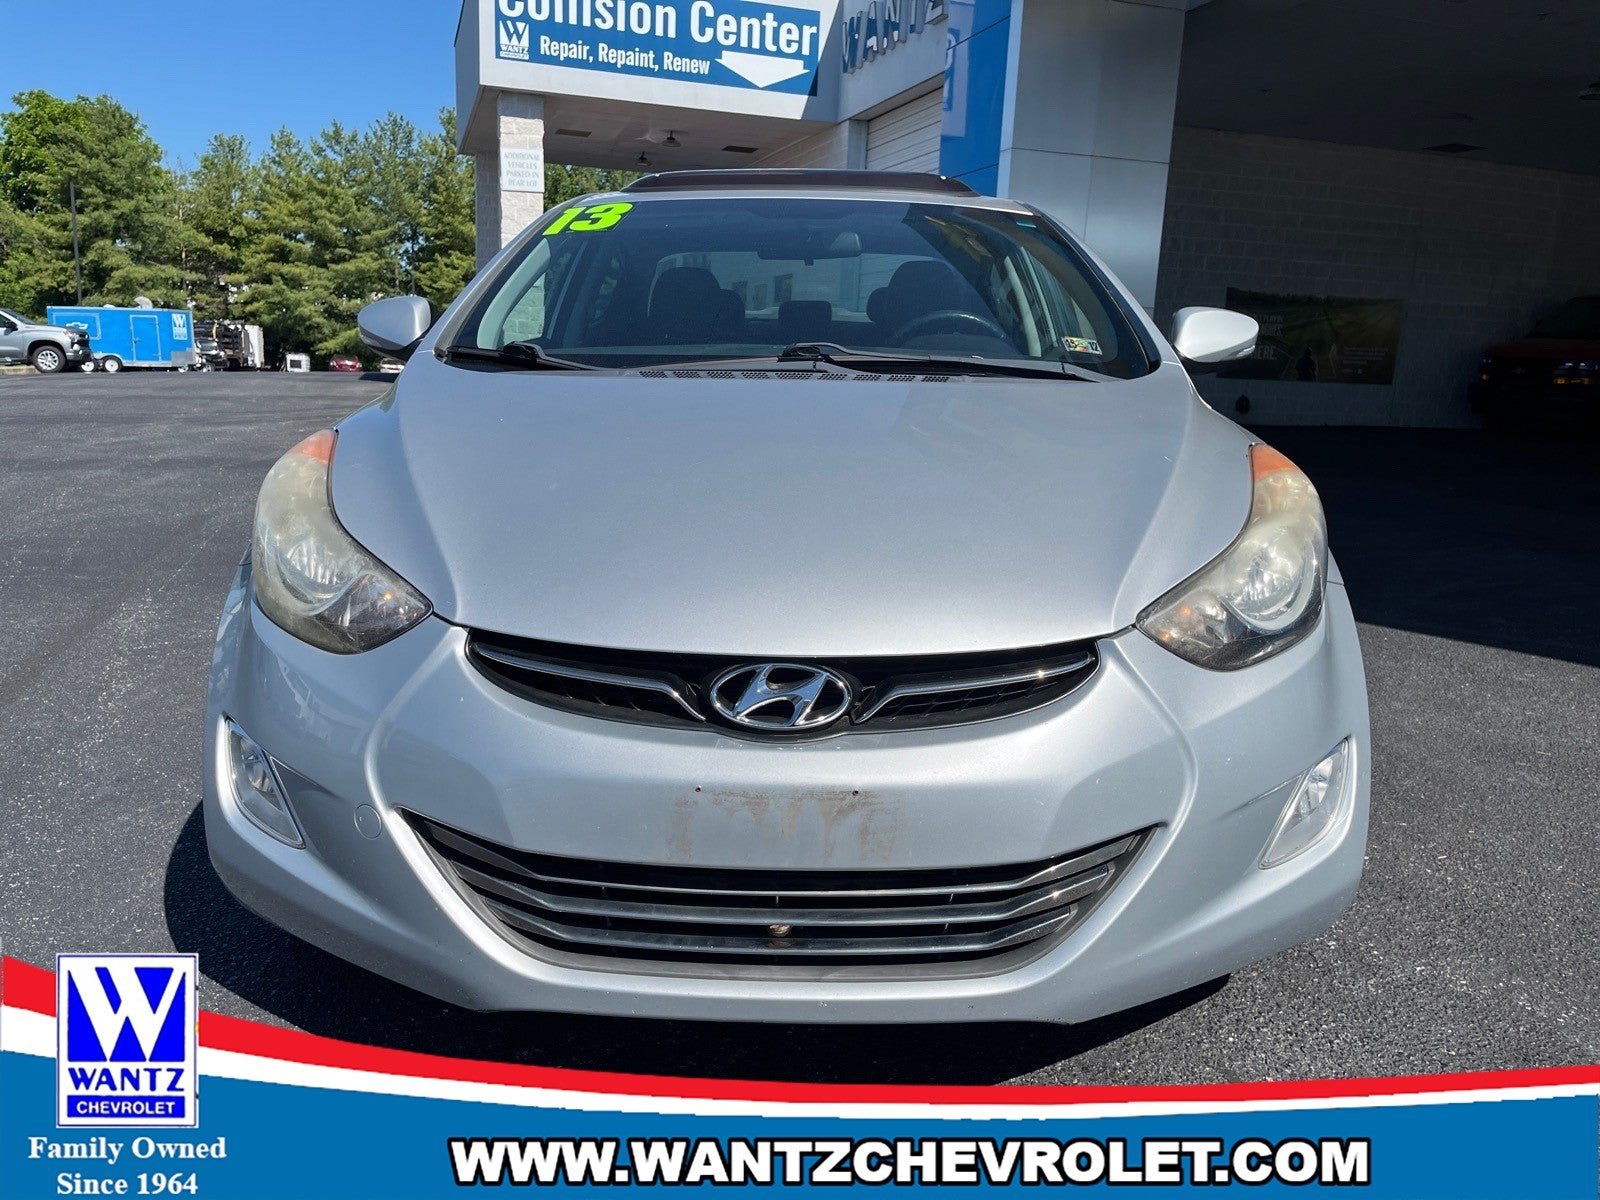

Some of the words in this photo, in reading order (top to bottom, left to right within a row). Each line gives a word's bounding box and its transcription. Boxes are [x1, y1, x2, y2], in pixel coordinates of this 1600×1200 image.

[690, 0, 817, 56] Center
[540, 35, 594, 63] Repair,
[598, 42, 659, 72] Repaint,
[664, 51, 710, 75] Renew
[504, 152, 539, 160] ADDITIONAL
[508, 161, 537, 170] VEHICLES
[506, 170, 530, 178] PARKED
[508, 178, 524, 186] REAR
[527, 179, 537, 187] LOT
[542, 203, 633, 235] 13
